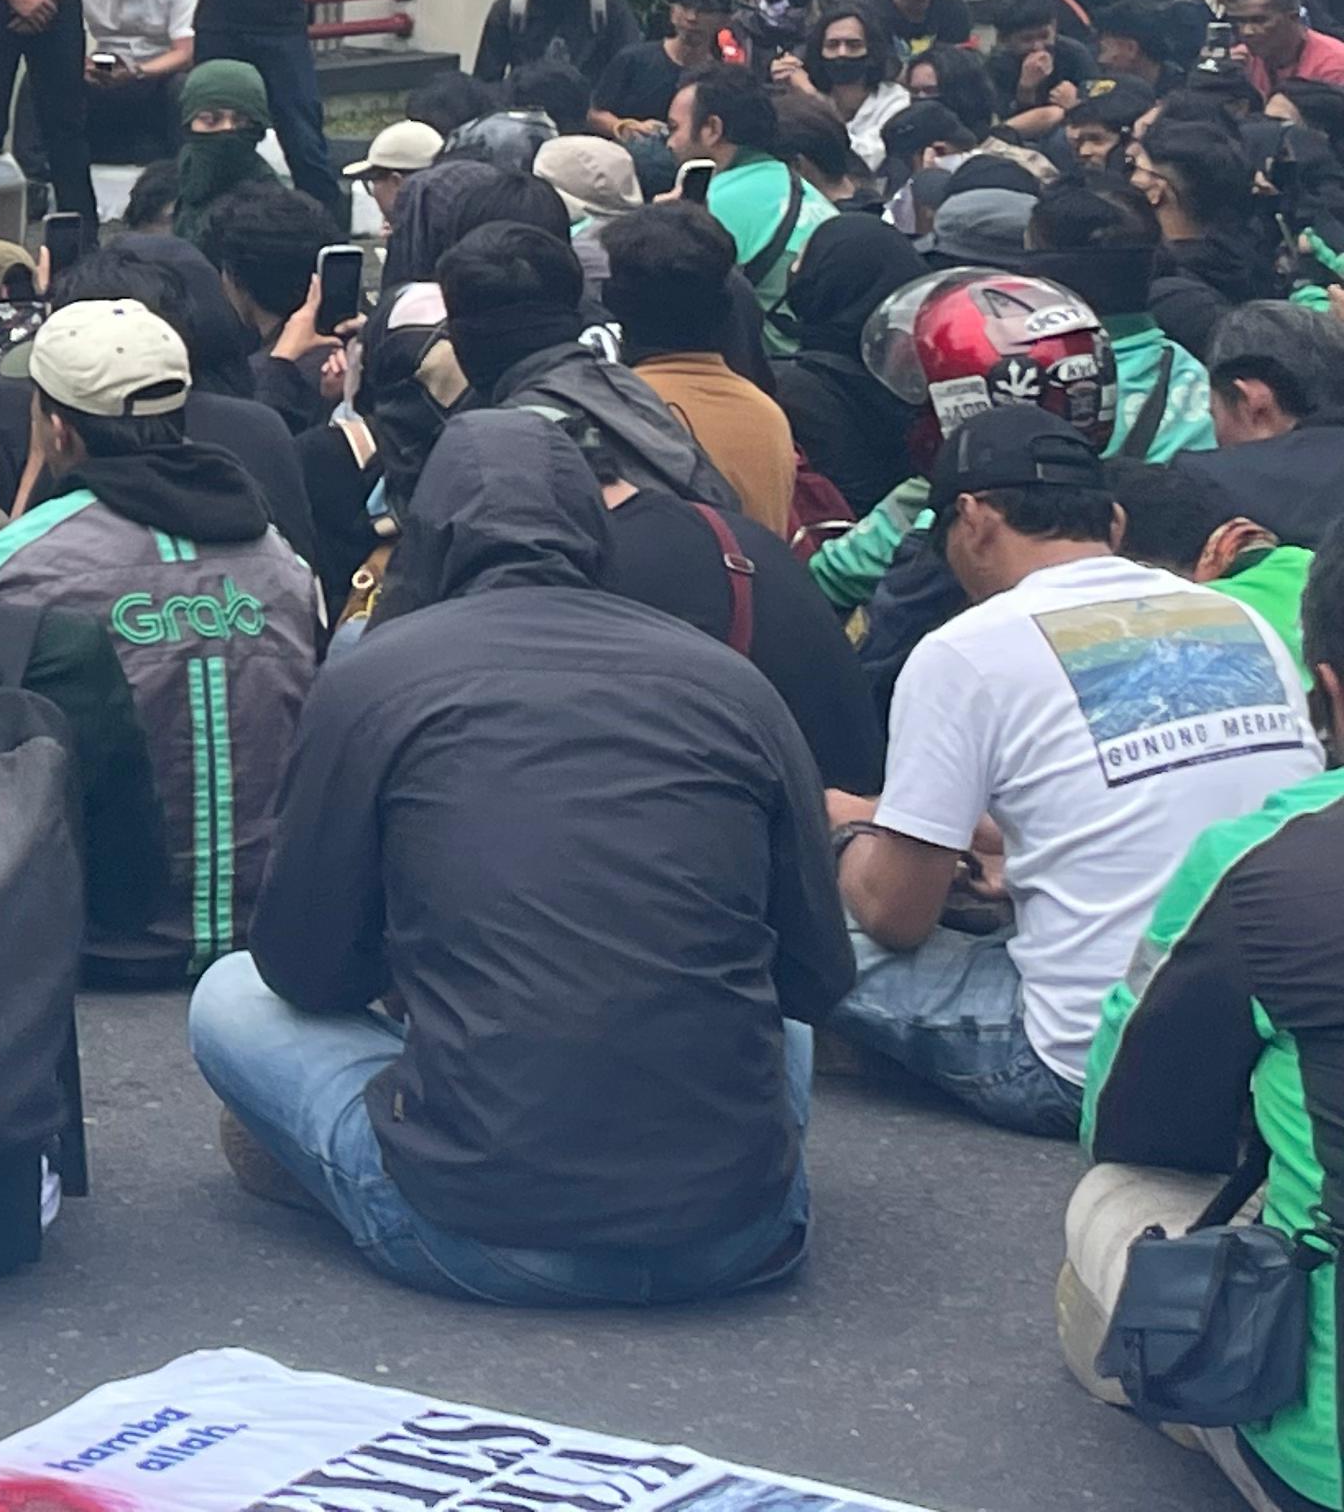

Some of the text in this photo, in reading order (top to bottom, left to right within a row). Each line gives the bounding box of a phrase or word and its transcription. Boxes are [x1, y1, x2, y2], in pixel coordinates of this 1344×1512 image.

[112, 576, 265, 644] Grab
[1108, 724, 1208, 767] GUNUNG
[43, 1406, 192, 1472] hamba
